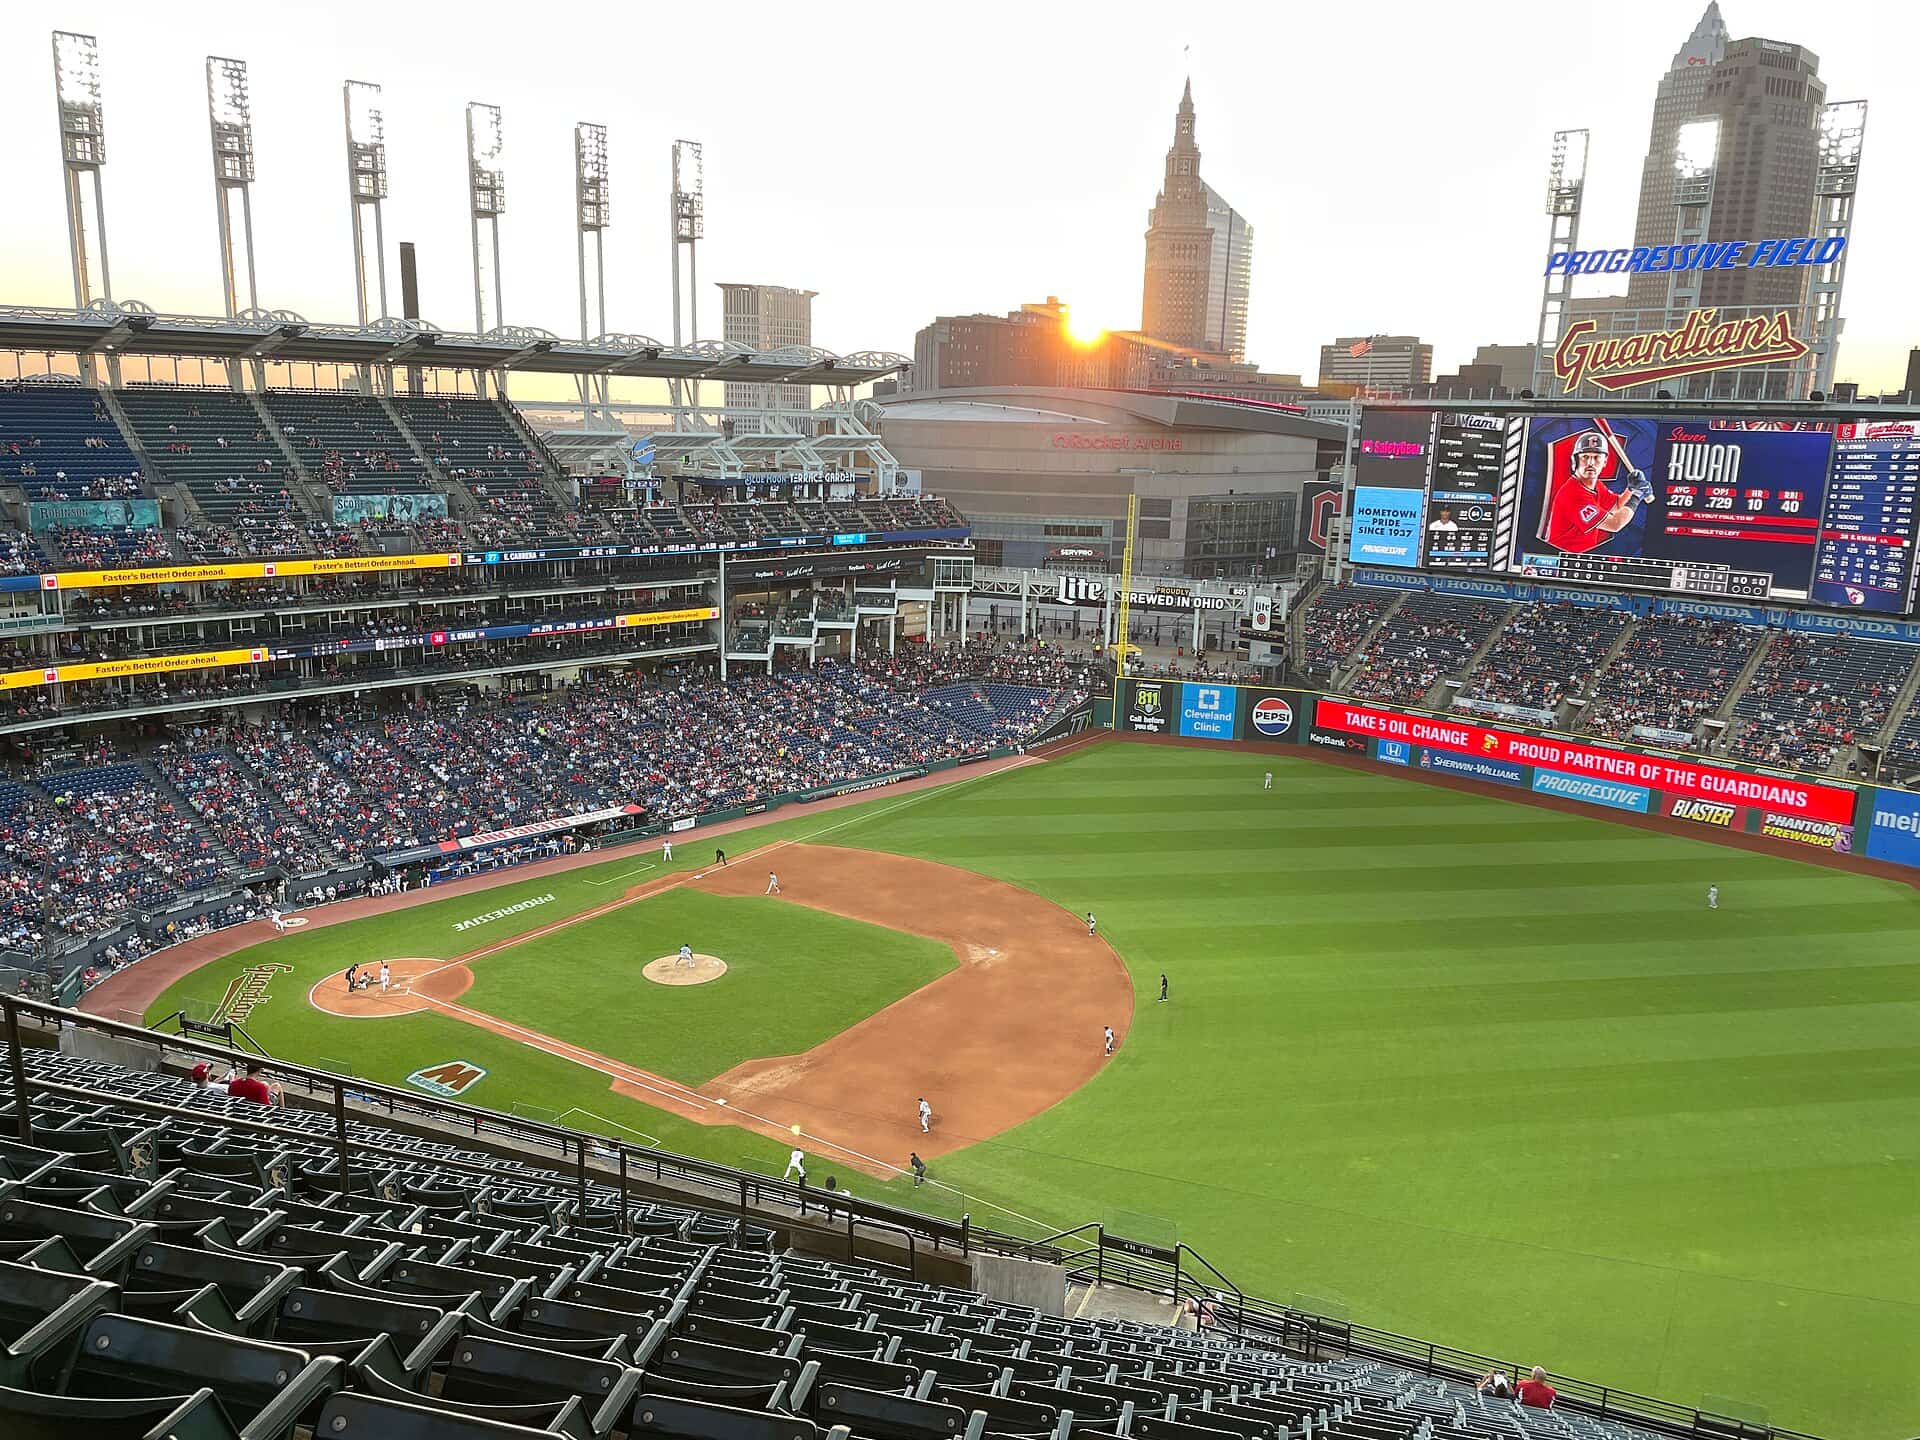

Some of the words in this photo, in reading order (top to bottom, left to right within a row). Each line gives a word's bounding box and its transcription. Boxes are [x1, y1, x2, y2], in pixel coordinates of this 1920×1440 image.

[1544, 241, 1746, 276] PROGRESSIVE
[1748, 236, 1846, 267] FIELD
[1554, 308, 1809, 393] Guardians
[1070, 432, 1128, 449] Rocket
[1134, 437, 1183, 450] Arena
[1668, 443, 1741, 483] KWAN
[745, 473, 764, 485] BLUE
[789, 472, 823, 483] TERRACE
[825, 472, 855, 483] GARDEN
[1673, 486, 1690, 494] AVG
[1712, 488, 1729, 496] OPS
[1752, 489, 1763, 497] HR
[1784, 490, 1798, 499] RBI
[1666, 494, 1693, 507] .276
[1705, 496, 1732, 509] .729
[1747, 499, 1763, 511] 10
[1781, 500, 1799, 513] 40
[40, 507, 88, 520] ROBINSON
[1358, 507, 1417, 519] HOMETOWN
[1372, 518, 1400, 527] PRIDE
[1358, 526, 1385, 536] SINCE
[1389, 528, 1412, 538] 1937
[1060, 548, 1093, 556] SERVPRO
[313, 562, 343, 571] Faster's
[345, 560, 370, 569] Better!
[371, 560, 392, 568] Order
[393, 558, 417, 567] ahead.
[102, 572, 138, 583] Faster's
[140, 570, 170, 581] Better!
[172, 569, 196, 579] Order
[198, 567, 226, 577] ahead.
[1373, 572, 1429, 586] HONDA
[1056, 575, 1103, 604] Lite
[1447, 581, 1507, 594] HONDA
[1127, 591, 1174, 608] REWED
[1177, 595, 1190, 608] IN
[1193, 597, 1224, 610] OHIO
[1556, 590, 1621, 606] HONDA
[1680, 602, 1753, 618] HONDA
[1816, 616, 1899, 634] HONDA
[95, 663, 131, 674] Faster's
[133, 660, 164, 672] Better!
[165, 658, 189, 669] Order
[190, 656, 219, 667] ahead.
[1138, 690, 1158, 706] 811
[1129, 714, 1142, 722] Call
[1143, 715, 1165, 724] before
[1184, 709, 1232, 722] Cleveland
[1255, 711, 1290, 722] PEPSI
[1193, 721, 1221, 733] Clinic
[1345, 712, 1376, 730] TAKE
[1378, 719, 1386, 732] 5
[1389, 720, 1409, 736] OIL
[1412, 724, 1468, 746] CHANGE
[1310, 733, 1346, 748] KeyBank
[1433, 755, 1521, 781] SHERWIN-WILLIAMS.
[1509, 741, 1560, 763] PROUD
[1564, 751, 1635, 777] PARTNER
[1640, 764, 1662, 780] OF
[1664, 768, 1696, 787] THE
[1700, 773, 1808, 807] GUARDIANS
[1535, 774, 1642, 806] PROGRESSIVE
[1670, 799, 1736, 826] BLASTER
[469, 820, 571, 844] CLEVELAND
[1765, 813, 1837, 837] PHANTOM
[1762, 825, 1834, 847] FIREWORKS
[452, 893, 556, 932] PROGRESSIVE
[418, 1063, 482, 1091] M
